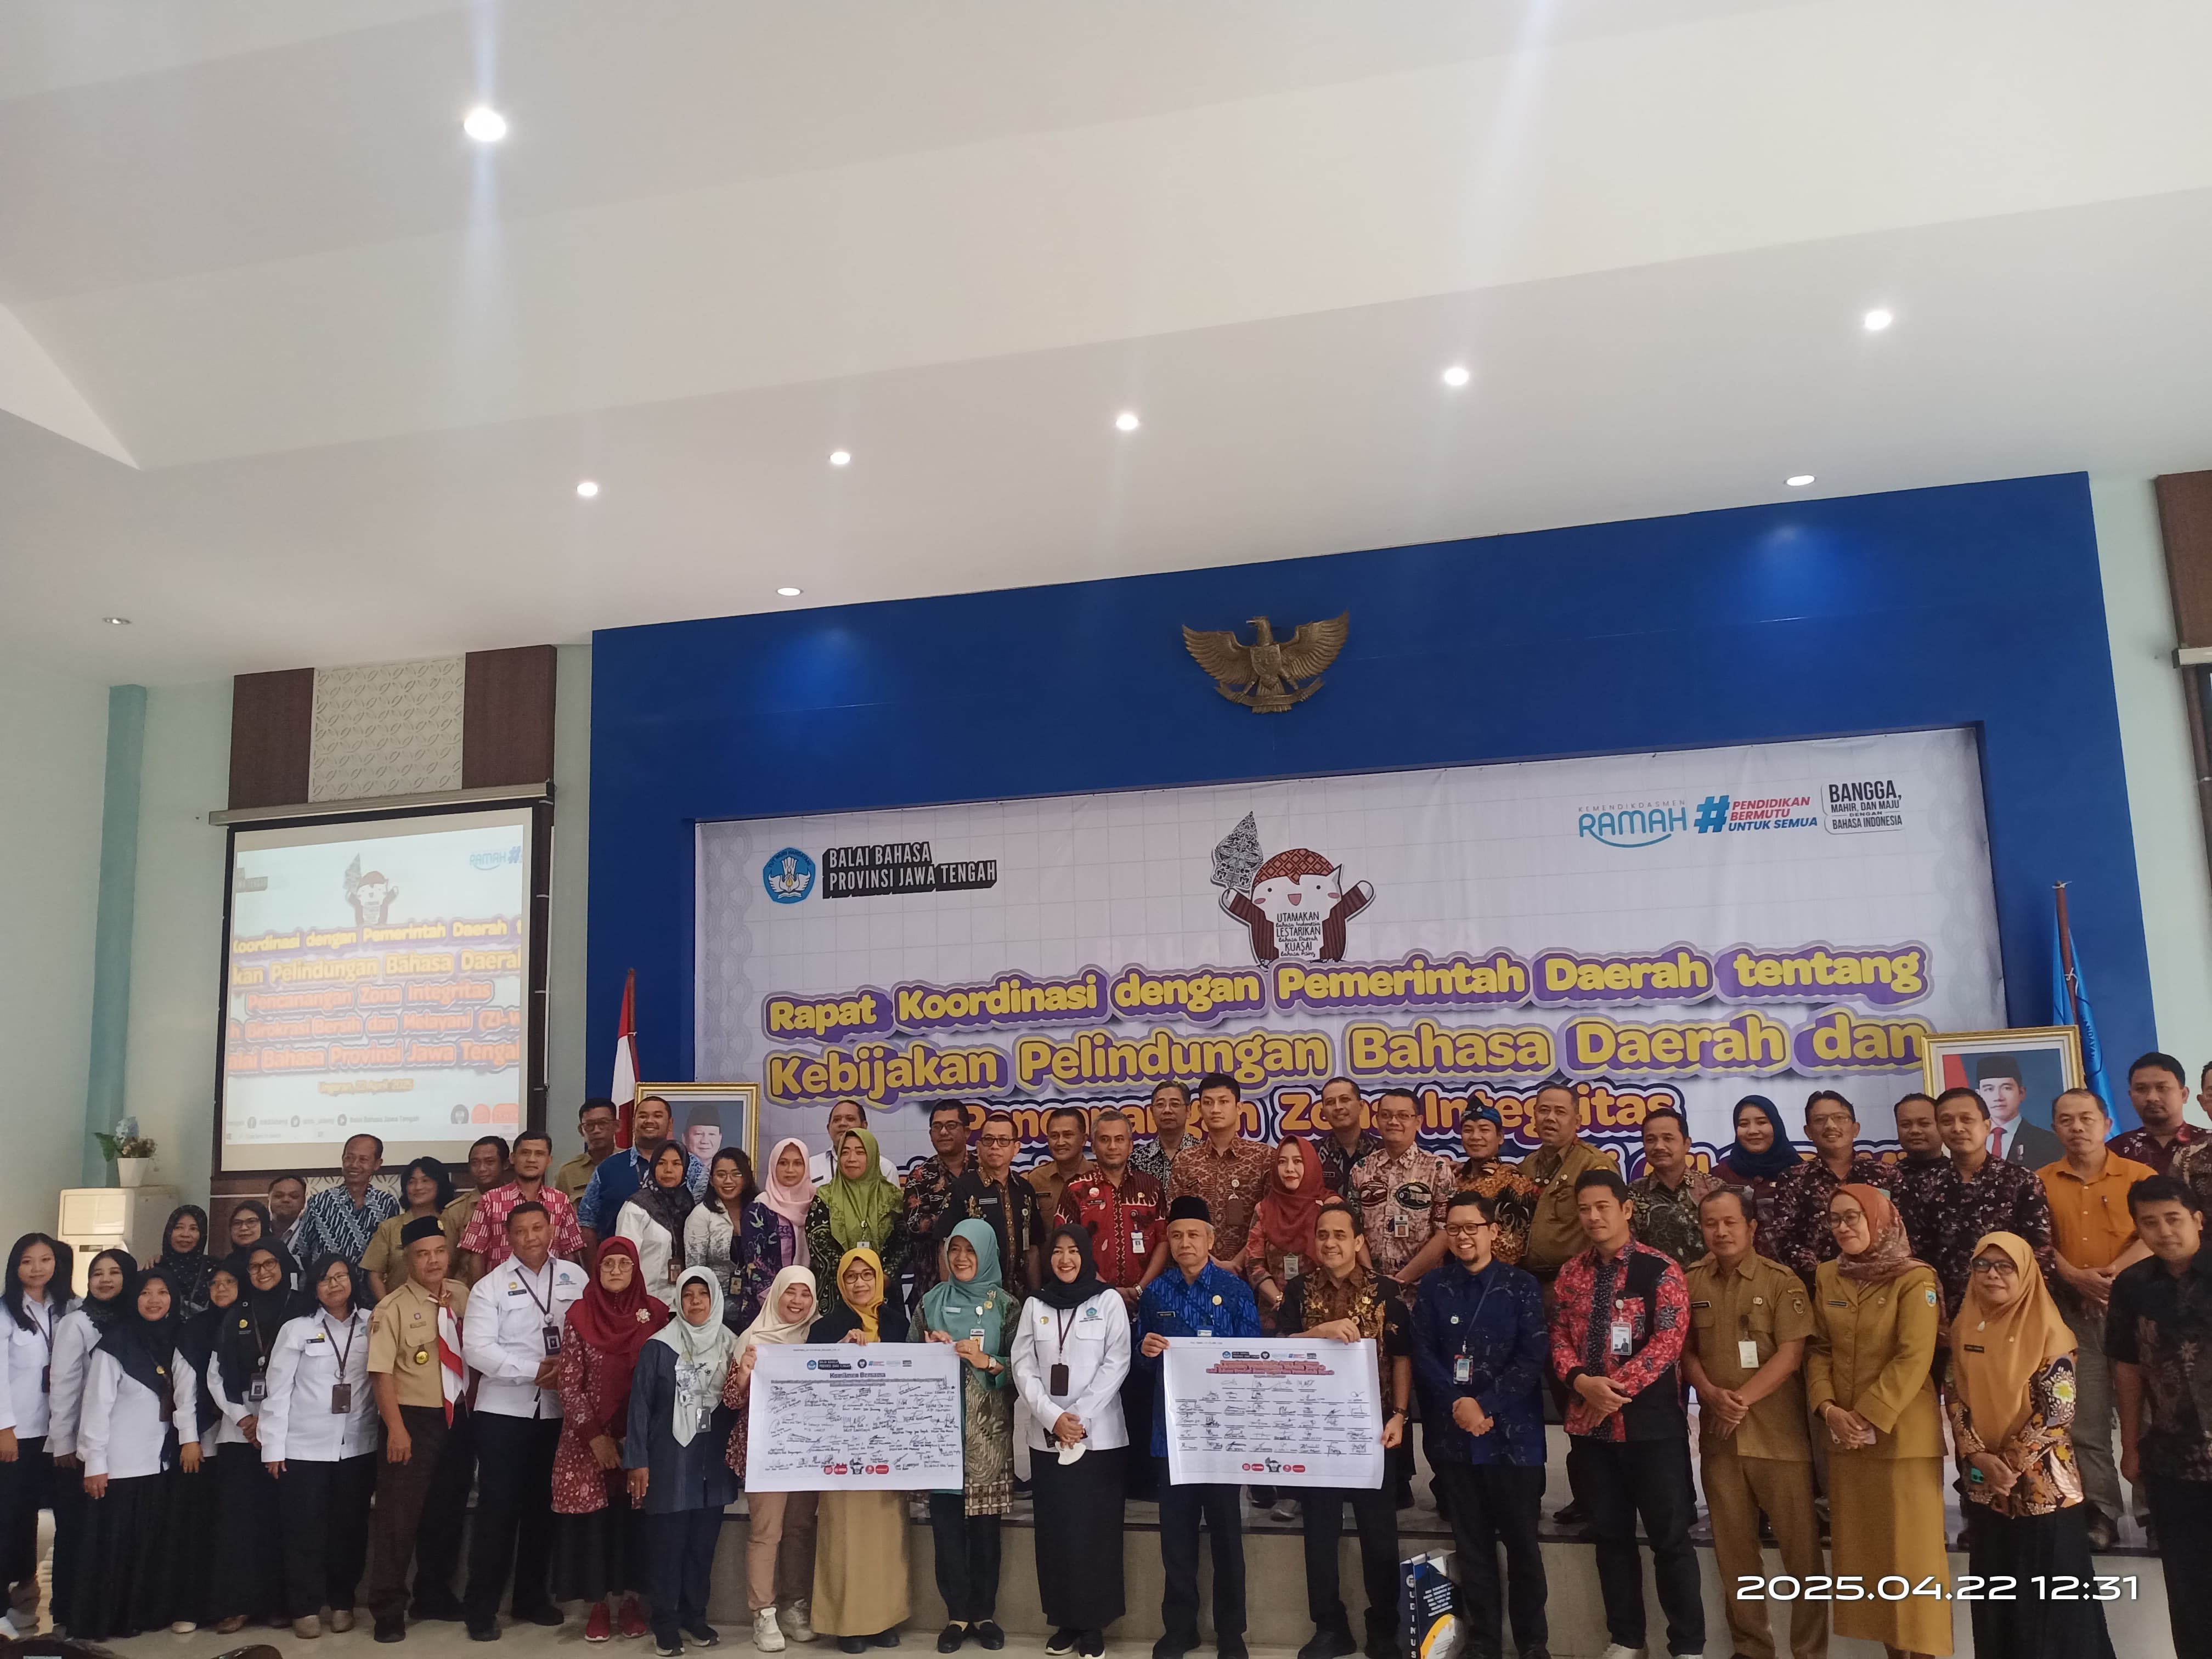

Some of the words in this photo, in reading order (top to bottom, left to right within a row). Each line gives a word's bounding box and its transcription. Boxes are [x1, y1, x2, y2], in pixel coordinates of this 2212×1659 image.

[1732, 797, 1811, 810] PENDIDIKAN
[1829, 780, 1902, 803] BANGGA,
[1578, 799, 1685, 812] KEMENDIKDASMEN
[1730, 808, 1791, 821] BERMUTU
[1831, 803, 1859, 813] MAHIR,
[1860, 801, 1877, 811] DAN
[1878, 799, 1900, 809] MAJU
[1578, 807, 1688, 838] RAMAH
[1728, 820, 1770, 832] UNTUK
[1774, 817, 1818, 829] SEMUA
[1832, 817, 1863, 830] BAHASA
[1863, 815, 1903, 827] INDONESIA
[829, 847, 870, 868] BALAI
[874, 843, 930, 865] BAHASA
[830, 868, 894, 891] PROVINSI
[899, 866, 935, 887] JAWA
[940, 861, 996, 884] TENGAH
[1277, 911, 1319, 922] UTAMAKAN
[306, 932, 357, 950] dengan
[363, 922, 447, 943] Pemerintah
[452, 918, 508, 938] Daerah
[1276, 926, 1321, 938] LESTARIKAN
[1285, 941, 1312, 951] KUASAI
[270, 958, 379, 982] Pelindungan
[386, 952, 453, 974] Bahasa
[247, 991, 354, 1010] Pencanangan
[359, 986, 401, 1005] Zona
[407, 980, 492, 1005] Integritas
[770, 994, 877, 1035] Rapat
[898, 973, 1098, 1021] Koordinasi
[1114, 972, 1260, 1013] dengan
[1277, 957, 1525, 1000] Pemerintah
[1544, 951, 1709, 992] Daerah
[1733, 951, 1923, 994] tentang
[249, 1019, 312, 1038] Birokrasi
[313, 1016, 362, 1034] Bersih
[367, 1012, 398, 1031] dan
[403, 1009, 472, 1031] Melayani
[263, 1048, 326, 1069] Bahasa
[330, 1040, 403, 1065] Provinsi
[407, 1043, 456, 1063] Jawa
[769, 1045, 997, 1098] Kebijakan
[1021, 1031, 1326, 1084] Pelindungan
[1351, 1023, 1550, 1069] Bahasa
[1575, 1015, 1786, 1064] Daerah
[1812, 1013, 1922, 1060] dan
[1424, 1084, 1673, 1138] Inegitas
